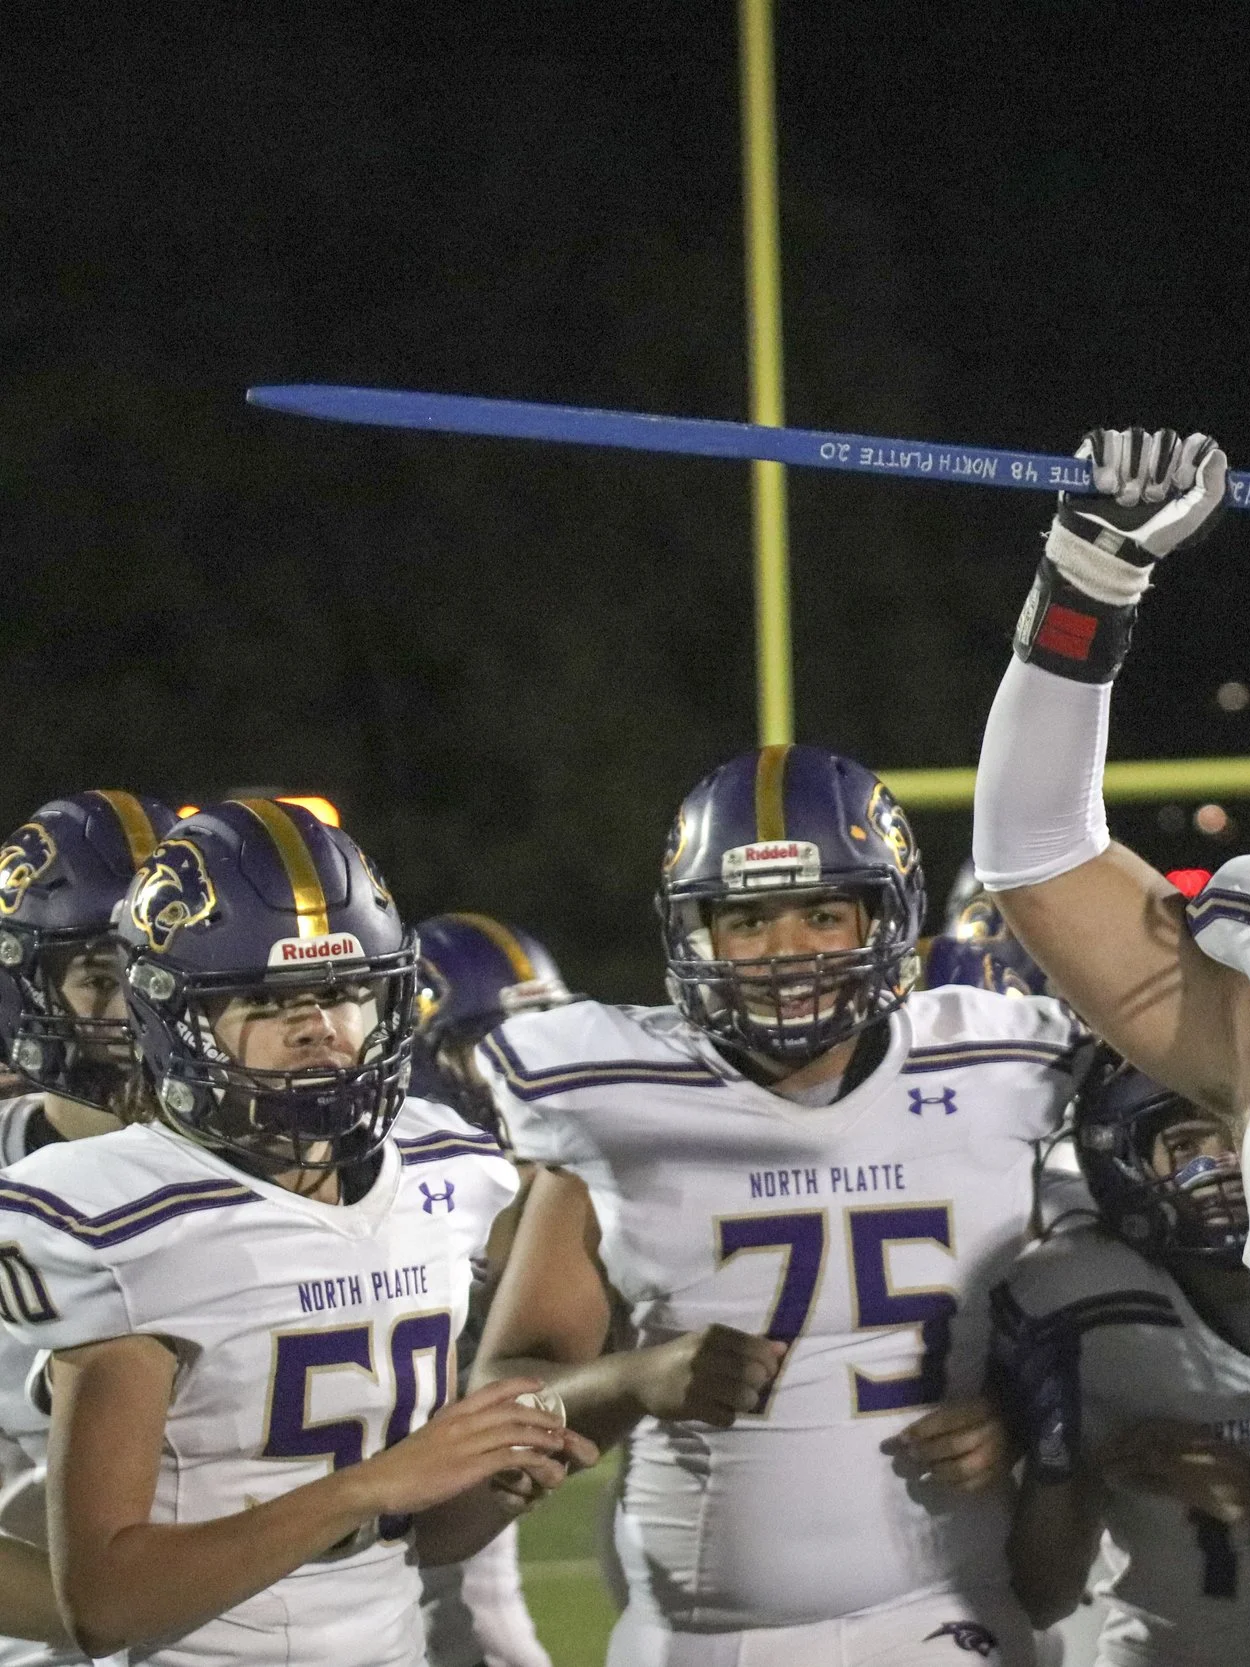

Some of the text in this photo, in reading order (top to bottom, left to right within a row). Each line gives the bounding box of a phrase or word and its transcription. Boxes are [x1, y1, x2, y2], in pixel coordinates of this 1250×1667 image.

[820, 442, 851, 462] 20
[860, 447, 933, 473] PLATTE
[939, 453, 998, 478] NORTH
[1011, 461, 1038, 483] 48
[745, 843, 799, 862] Riddell
[282, 940, 354, 961] Riddell
[750, 1164, 906, 1198] NORTH PLATTE
[0, 1240, 61, 1326] 0
[298, 1265, 428, 1313] NORTH PLATTE
[712, 1199, 957, 1420] 75
